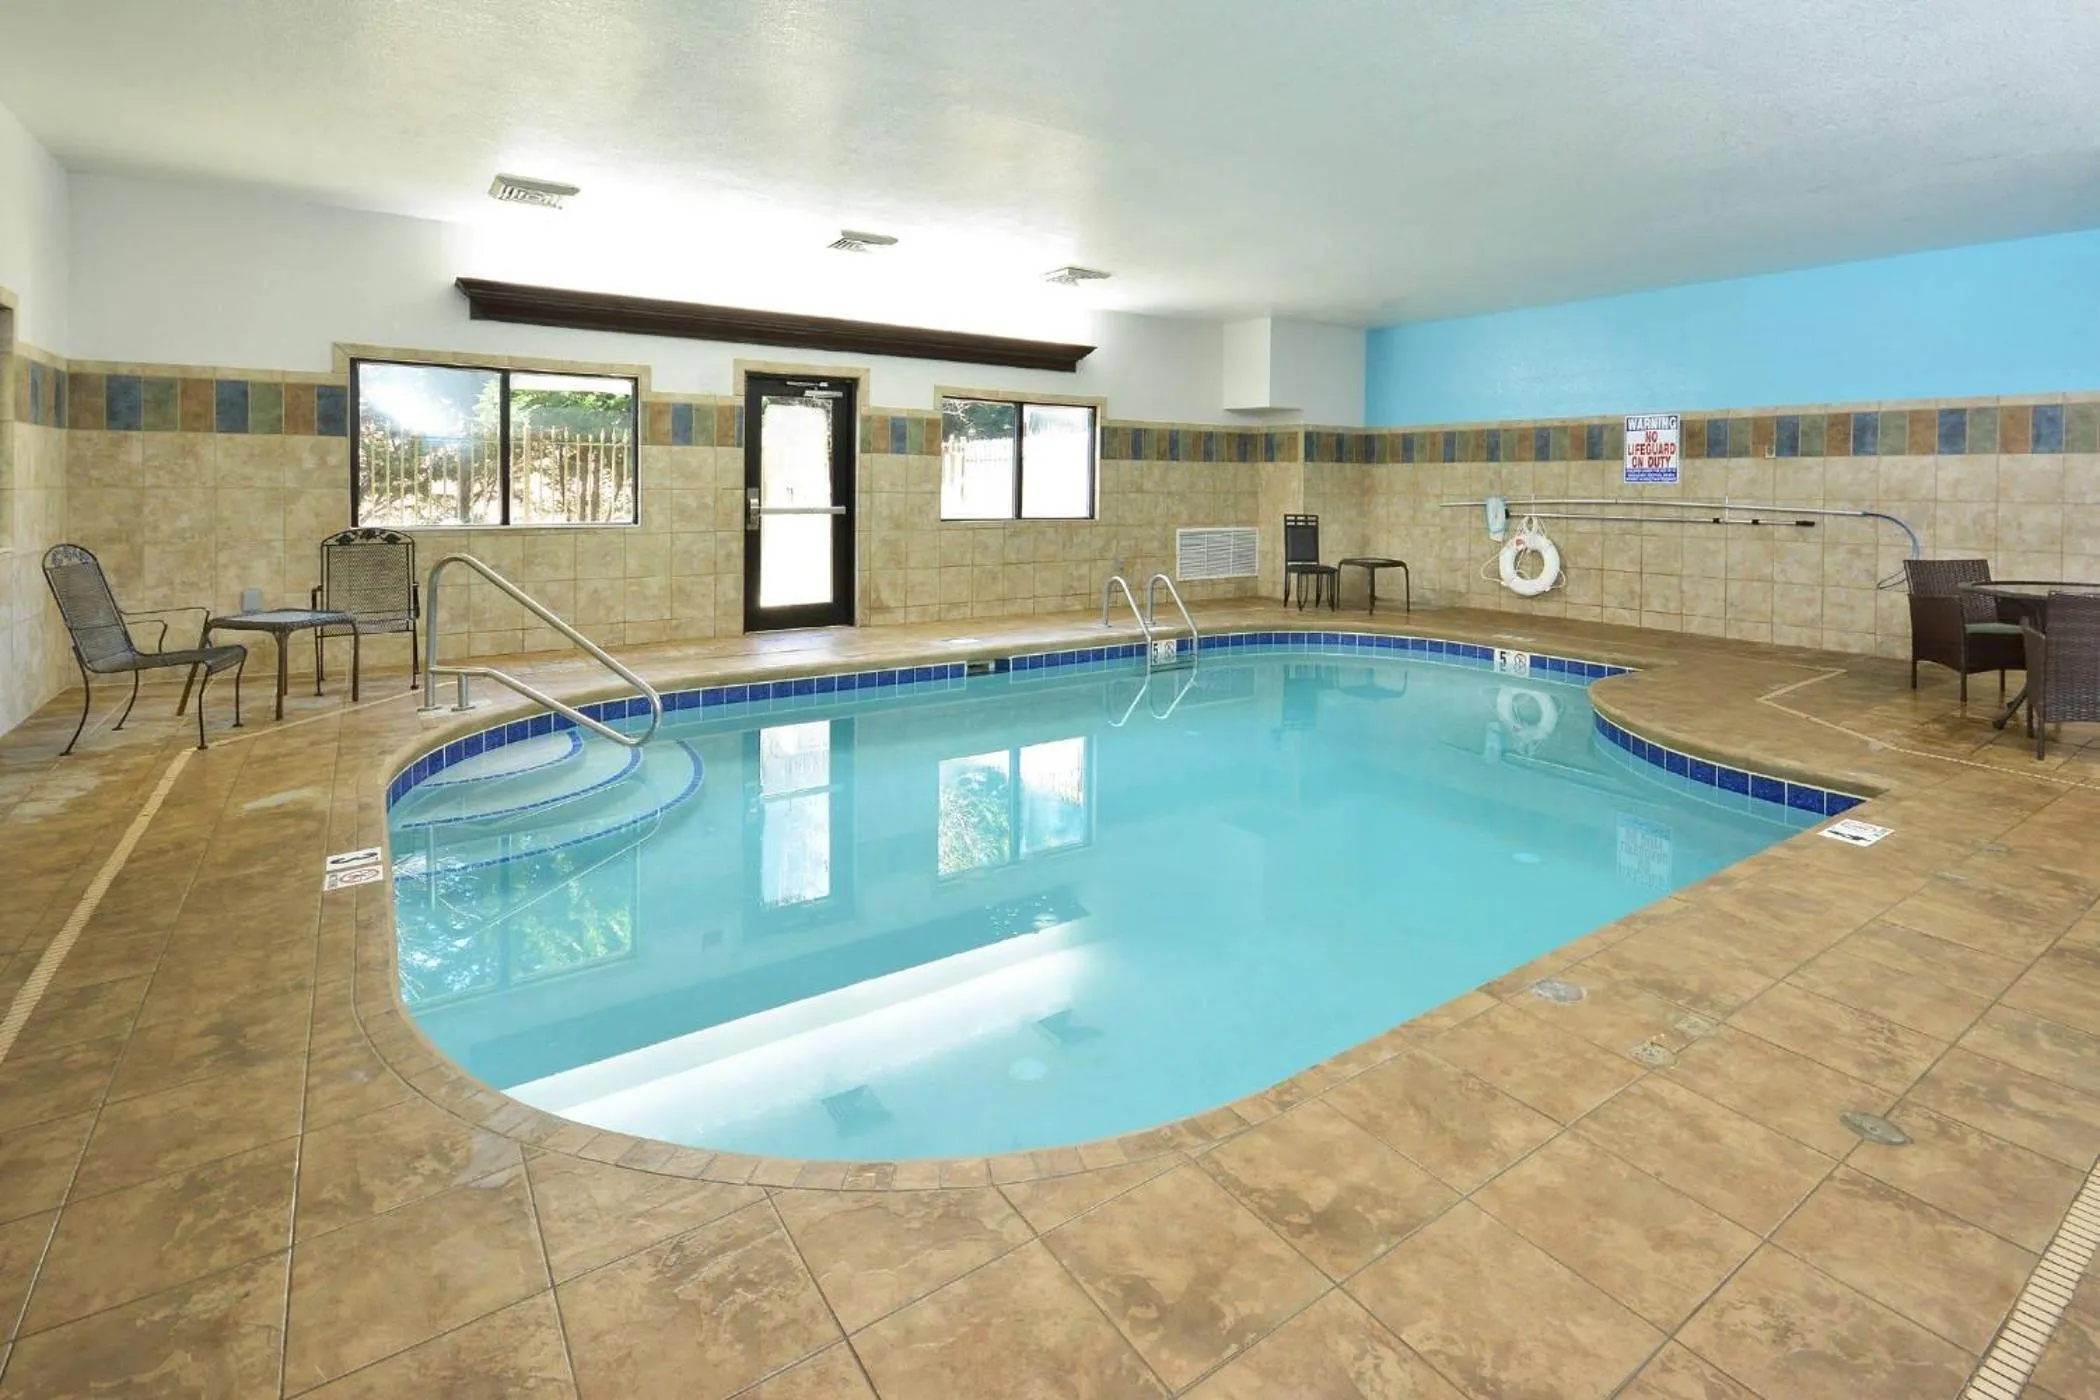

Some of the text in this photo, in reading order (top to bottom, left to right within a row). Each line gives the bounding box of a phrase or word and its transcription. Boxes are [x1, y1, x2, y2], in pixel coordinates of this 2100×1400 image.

[1627, 416, 1677, 430] WARNING
[1645, 430, 1658, 443] NO
[1627, 443, 1676, 455] LIFEGUARD
[1632, 455, 1671, 468] ON DUTY
[1500, 650, 1507, 667] 5
